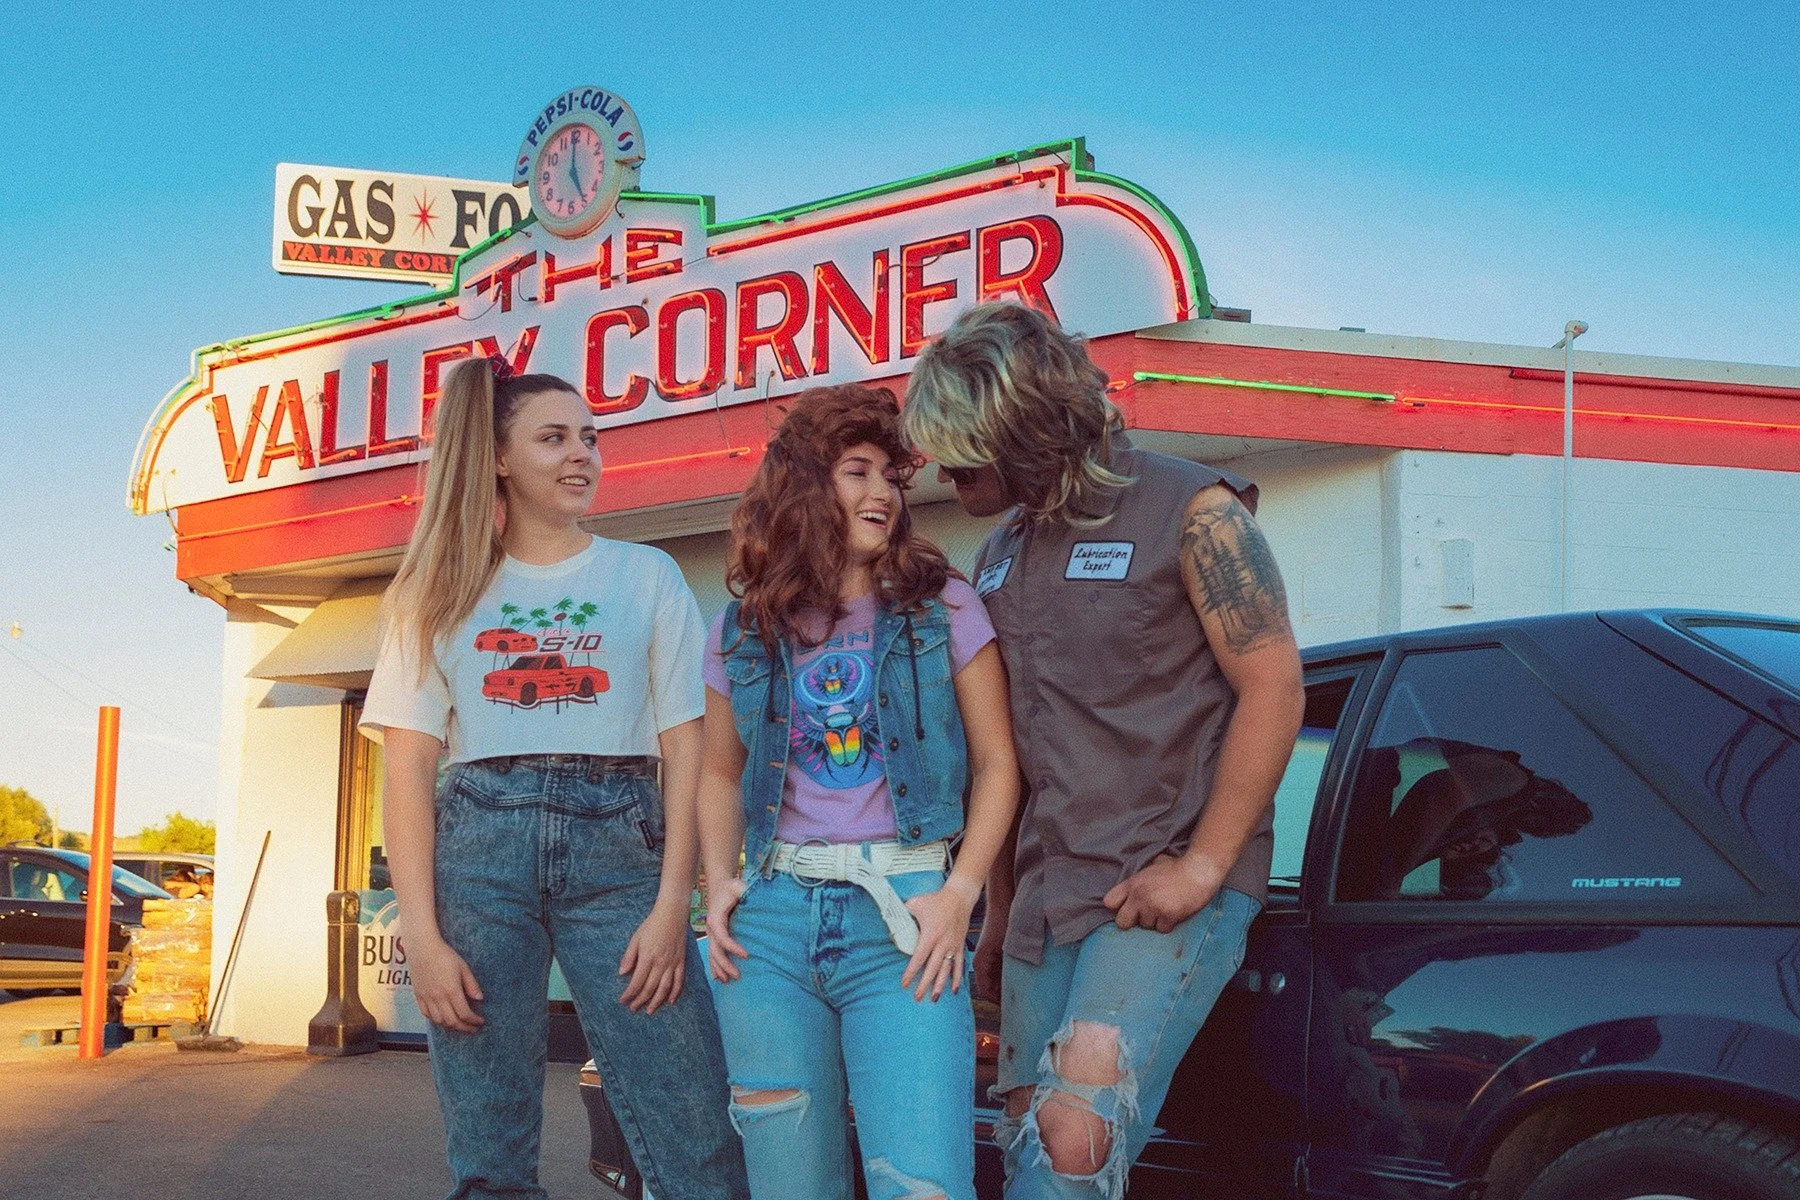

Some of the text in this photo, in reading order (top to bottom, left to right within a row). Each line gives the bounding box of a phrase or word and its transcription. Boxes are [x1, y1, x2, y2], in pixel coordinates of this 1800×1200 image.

[547, 152, 558, 167] 10
[288, 174, 395, 244] GAS
[284, 241, 457, 273] VALLEY COR
[466, 228, 683, 313] THE
[584, 214, 1063, 416] CORNER
[1074, 547, 1128, 559] Lubrication
[1083, 560, 1112, 573] Expert
[540, 634, 602, 652] S-10
[1571, 877, 1681, 888] MUSTANG
